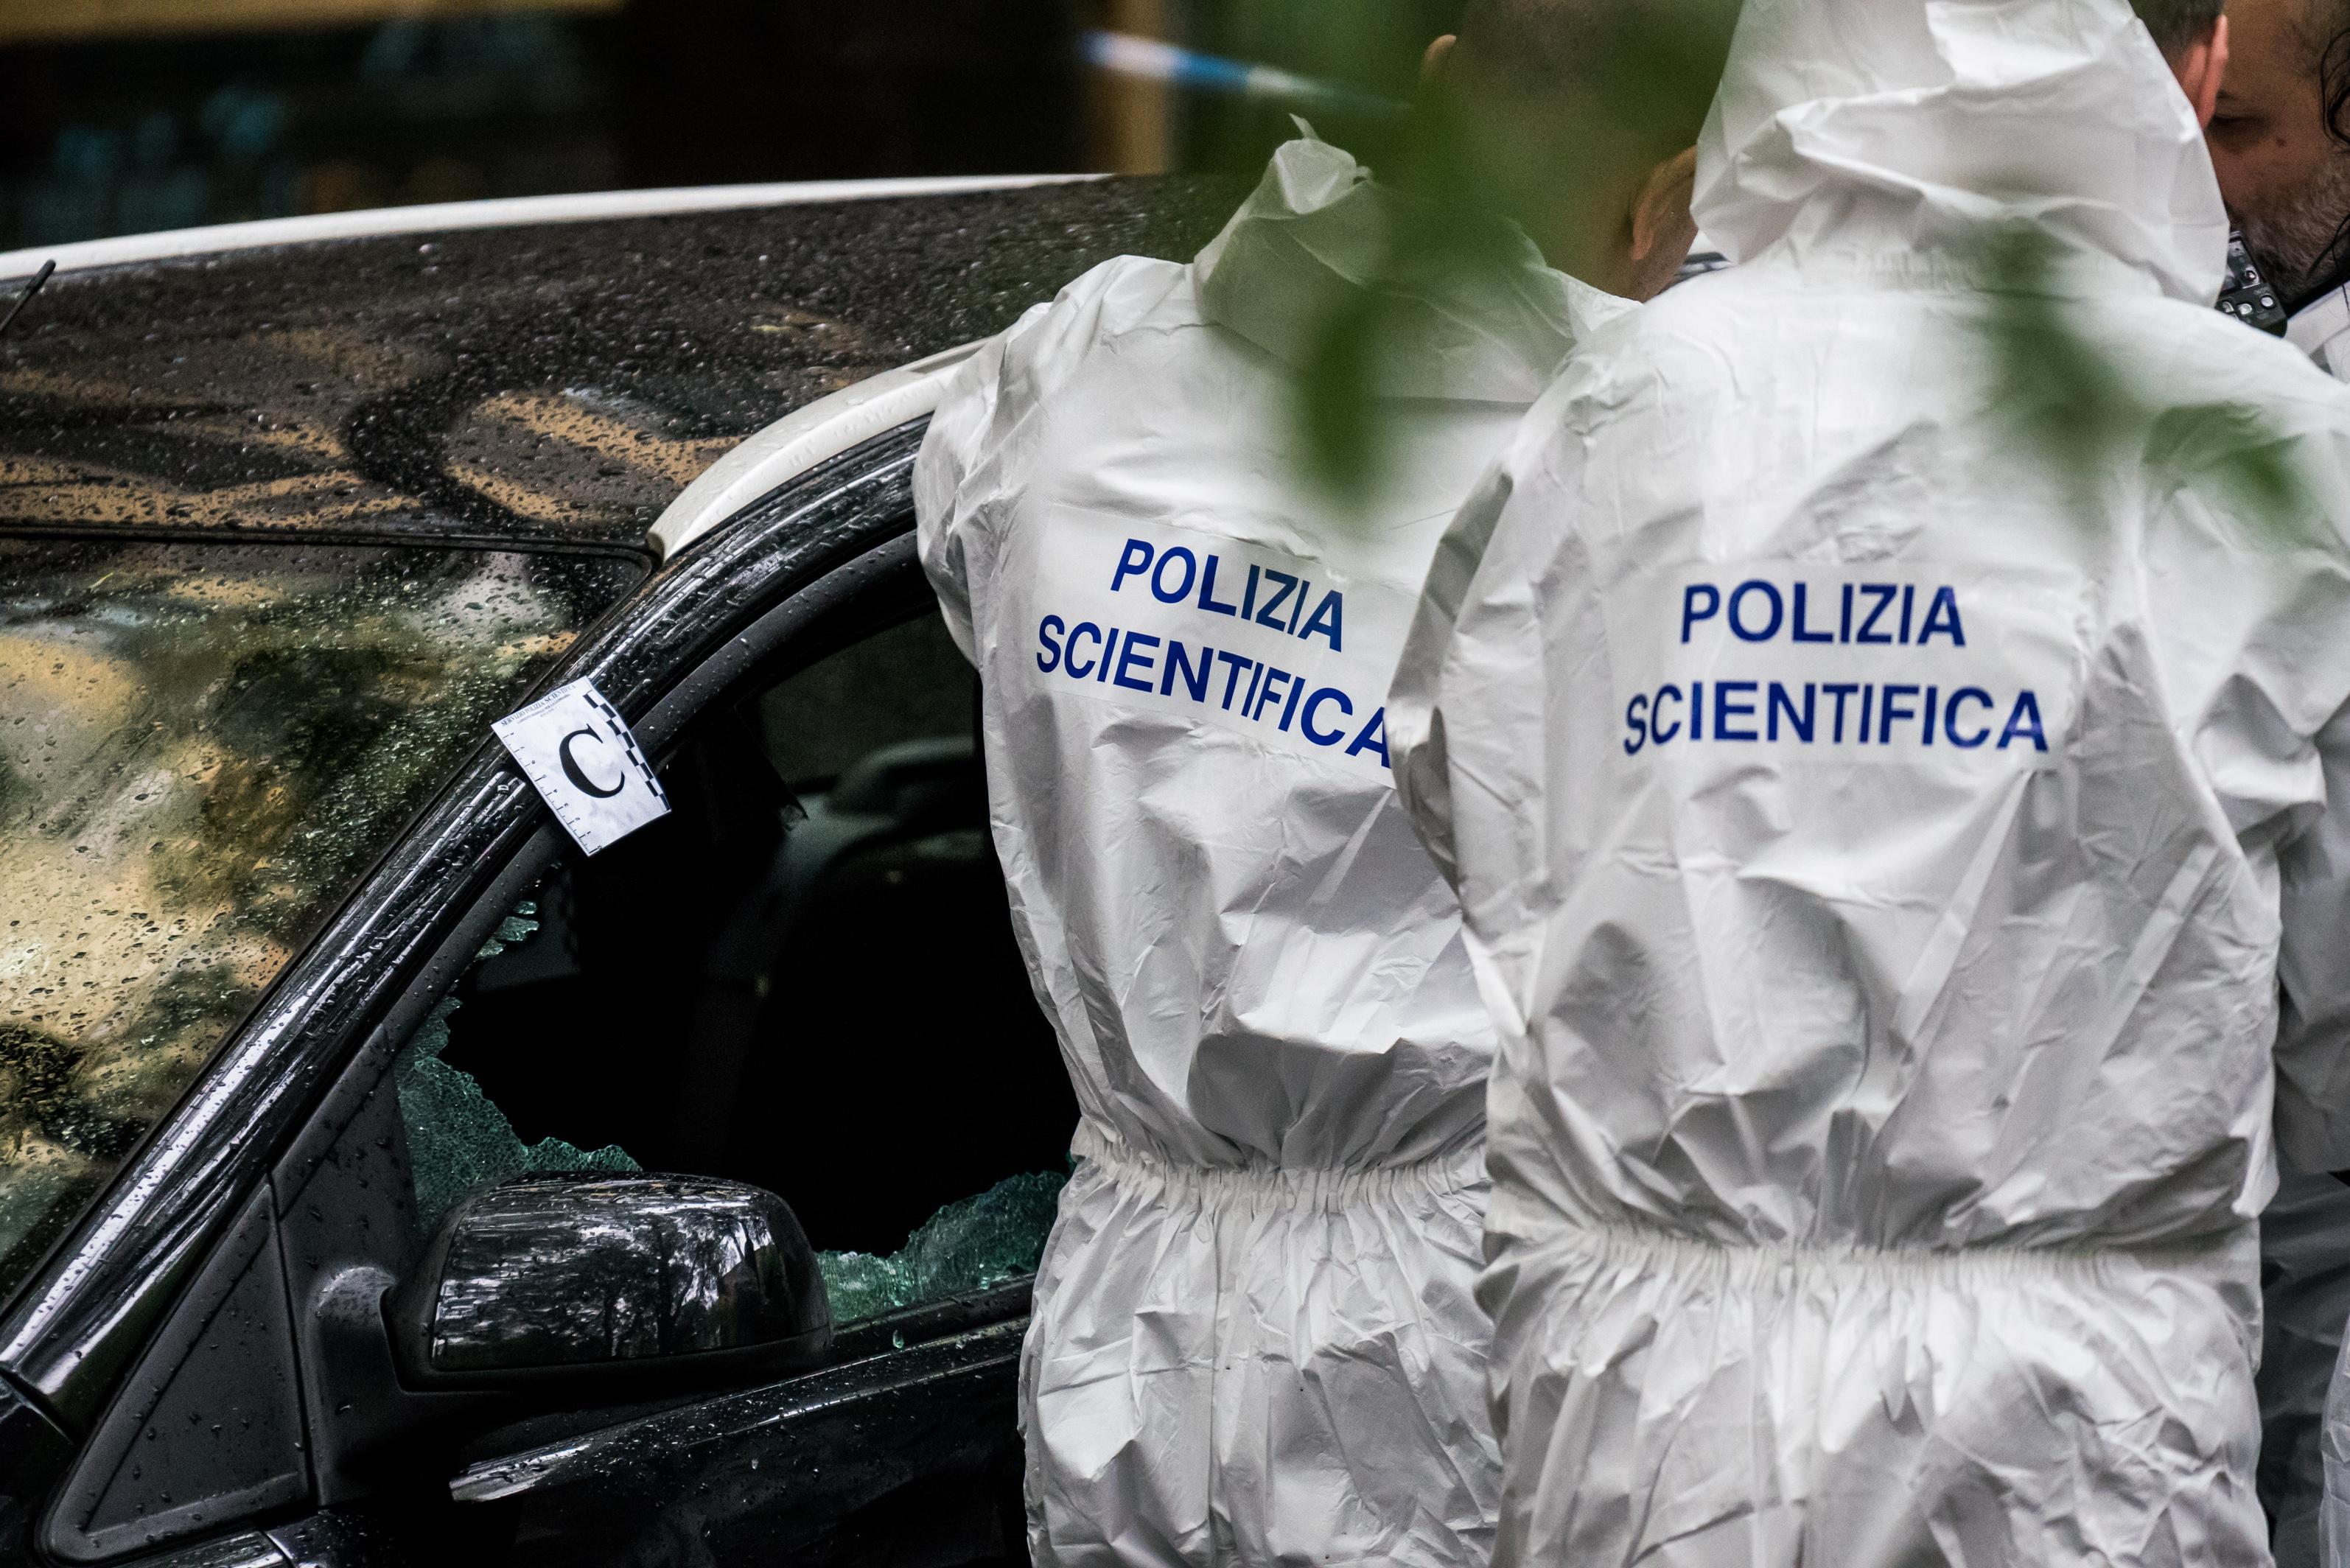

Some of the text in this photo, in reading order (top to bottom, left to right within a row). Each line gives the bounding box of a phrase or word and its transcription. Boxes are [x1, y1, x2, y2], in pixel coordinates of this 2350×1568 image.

[1111, 538, 1343, 652] POLIZIA
[1682, 578, 1965, 648] POLIZIA
[525, 701, 545, 715] POLIZIA
[1037, 615, 1391, 769] SCIENTIFICA
[1624, 681, 2047, 755] SCIENTIFICA
[559, 722, 626, 799] C
